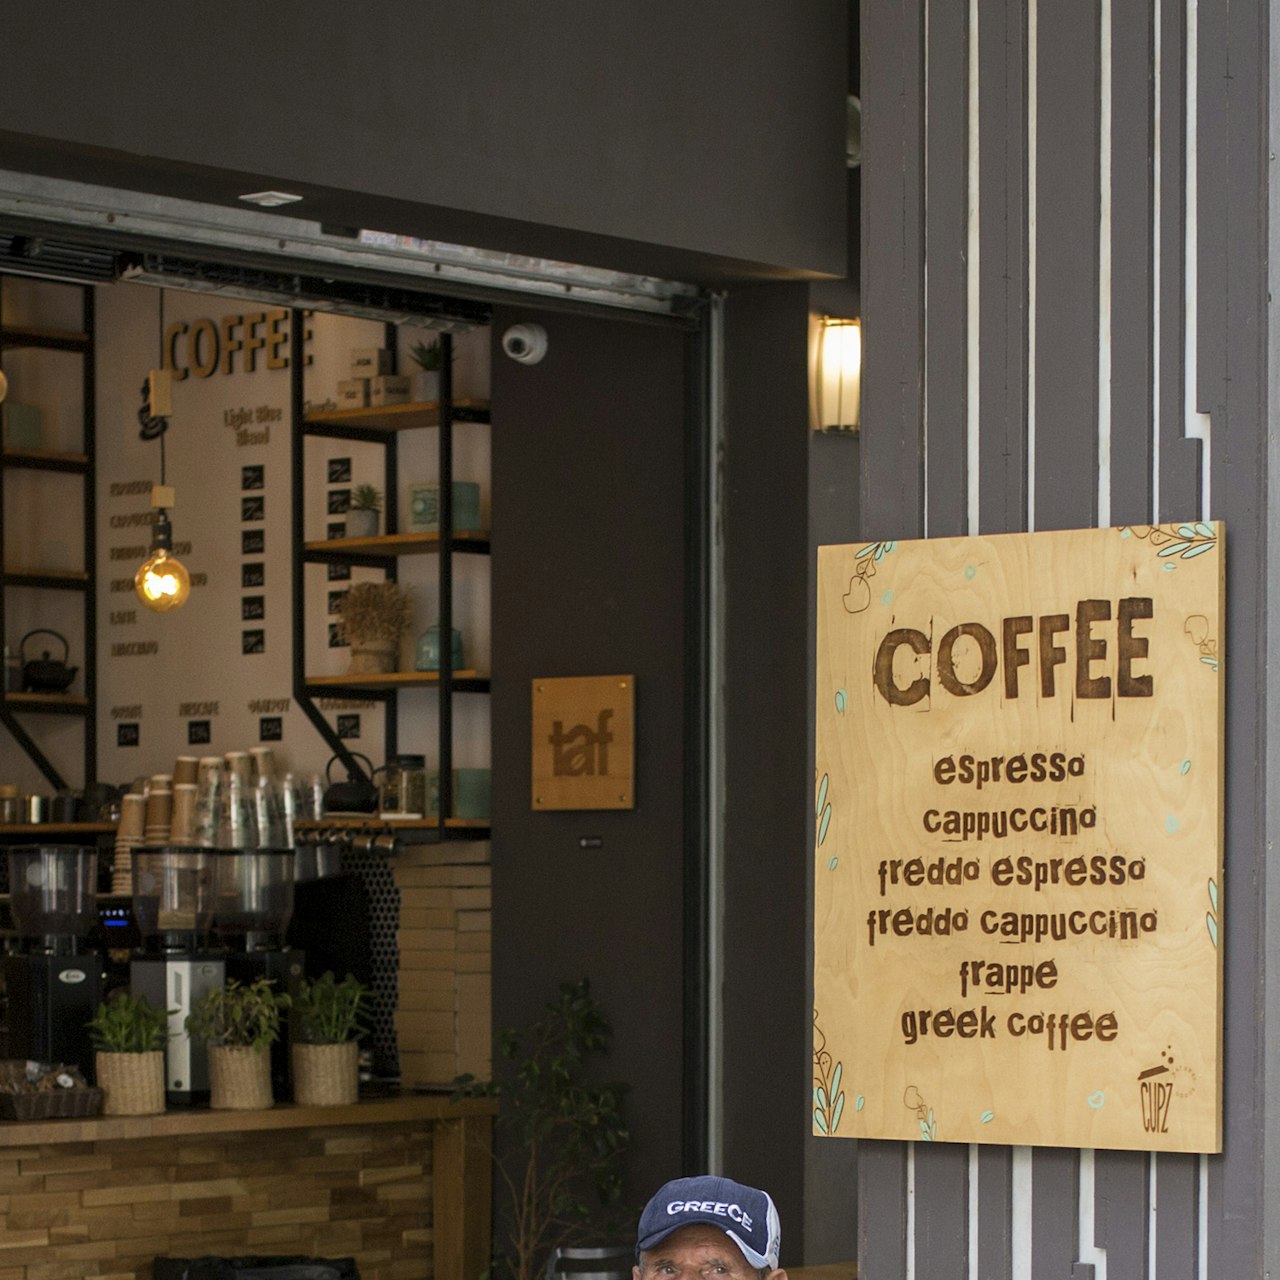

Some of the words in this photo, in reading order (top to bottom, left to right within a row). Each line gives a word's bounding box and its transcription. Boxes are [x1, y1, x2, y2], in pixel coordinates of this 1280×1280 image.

[872, 597, 1154, 707] COFFEE
[548, 708, 614, 776] taf
[933, 752, 1086, 790] espresso
[922, 804, 1098, 841] cappuccino
[878, 855, 981, 896] freddo
[991, 854, 1146, 891] espresso
[867, 906, 969, 946] freddo
[980, 907, 1158, 943] cappuccino
[959, 958, 1059, 998] frappe
[901, 1006, 996, 1045] greek
[1007, 1010, 1119, 1051] coffee
[1140, 1081, 1174, 1134] CUPZ
[666, 1200, 753, 1233] GREECE
